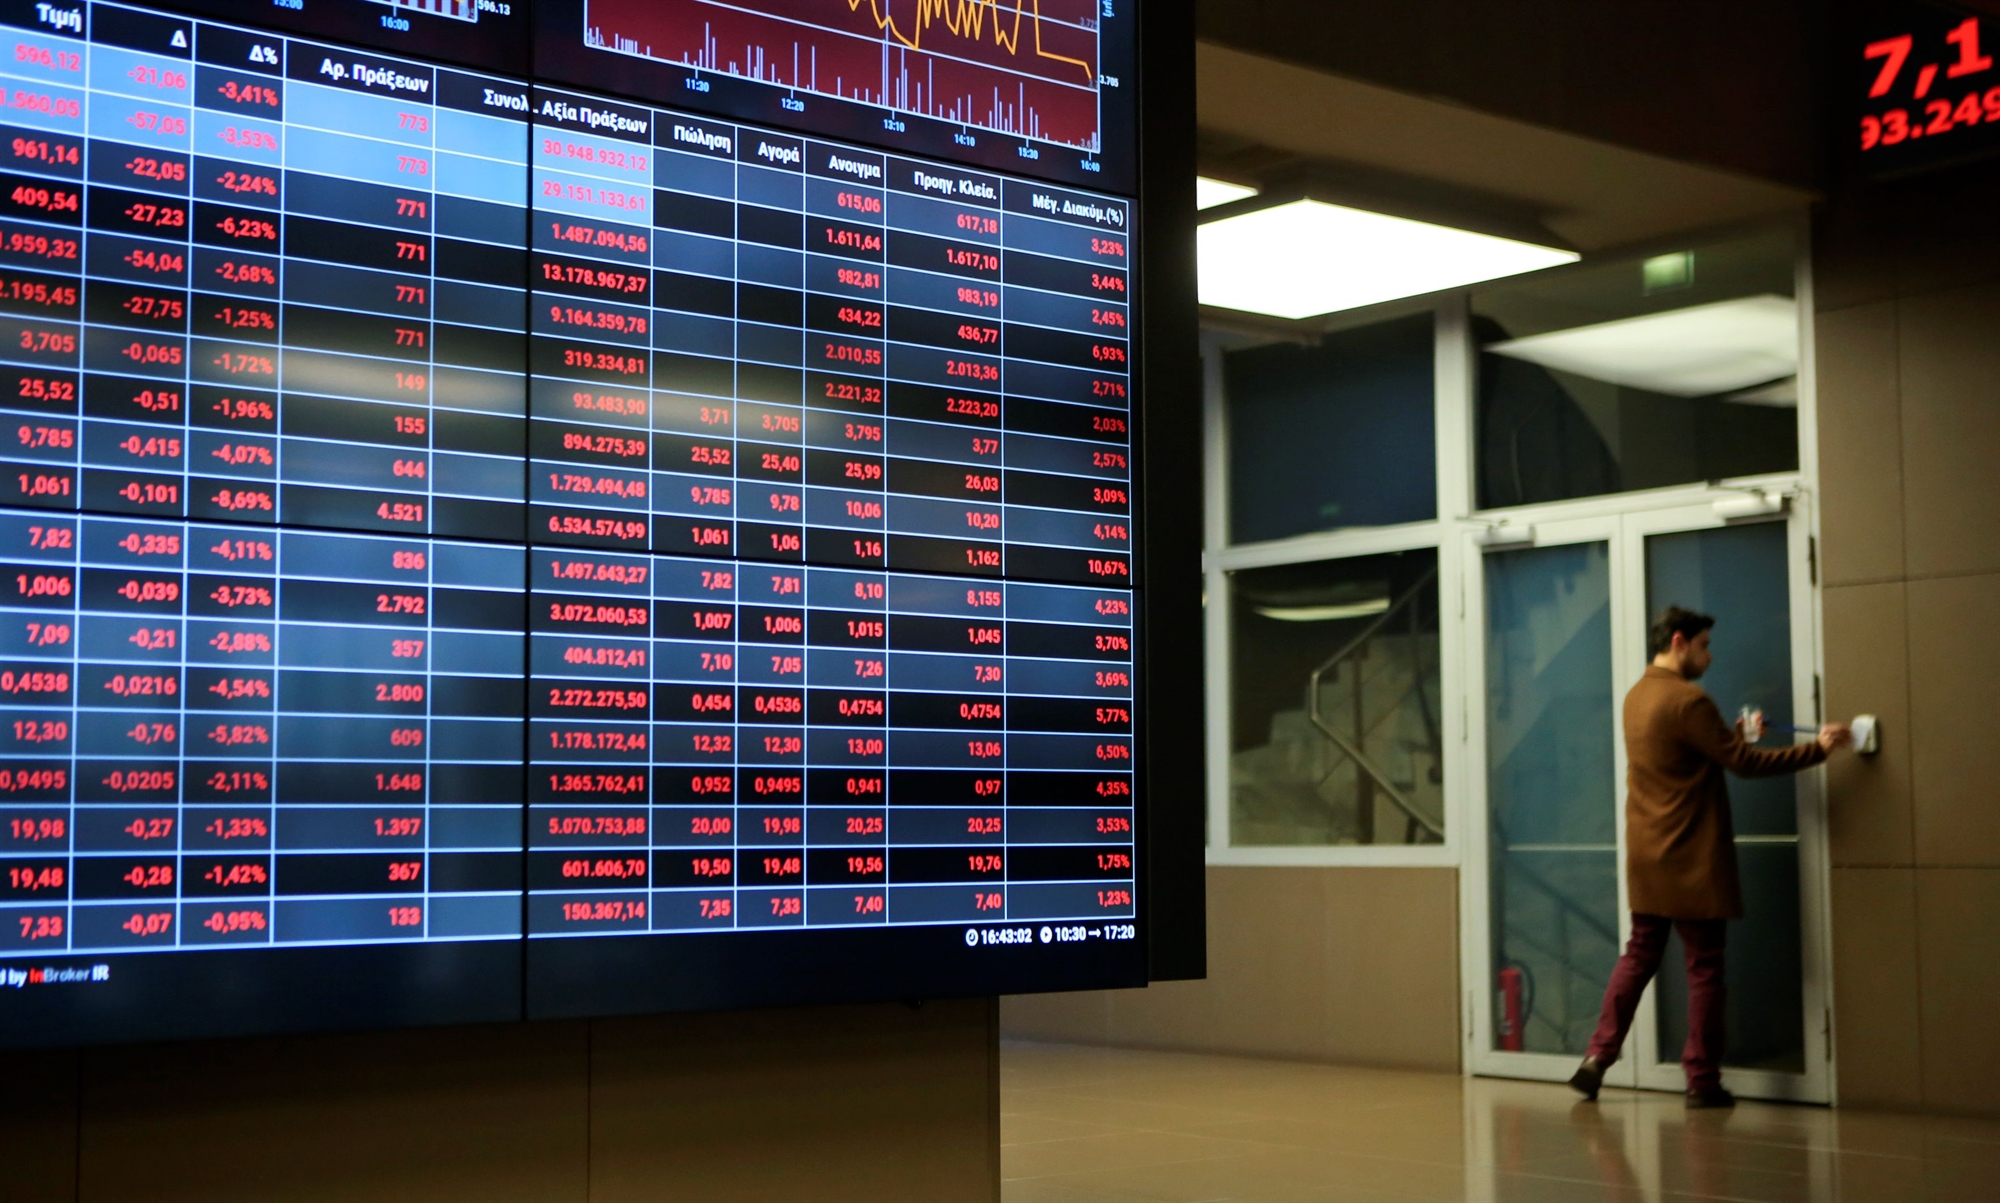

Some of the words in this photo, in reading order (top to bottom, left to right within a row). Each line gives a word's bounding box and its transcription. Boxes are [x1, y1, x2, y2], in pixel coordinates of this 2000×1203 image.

[381, 16, 410, 31] 16:00
[478, 0, 511, 16] 596.13
[1864, 16, 1993, 100] 7,1
[685, 78, 710, 93] 11:30
[781, 98, 804, 113] 12:20
[36, 3, 82, 33] Τιμή
[170, 30, 187, 48] Δ
[249, 45, 278, 65] Δ%
[320, 58, 349, 80] Αρ.
[353, 63, 429, 93] Πράξεων
[541, 100, 577, 122] Αξία
[580, 107, 648, 134] Πράξεων
[674, 125, 731, 153] Πώληση
[757, 141, 800, 164] Αγορά
[828, 155, 881, 179] Ανοιγμα
[914, 171, 957, 194] Προηγ.
[959, 180, 997, 200] Κλείσ.
[1032, 194, 1060, 215] Μέγ.
[883, 119, 906, 133] 13:10
[954, 133, 976, 147] 14:10
[1018, 146, 1039, 160] 15:30
[218, 81, 279, 107] -3,41%
[837, 191, 882, 213] 615,06
[957, 213, 999, 234] 617,18
[1091, 237, 1125, 257] 3,23%
[1080, 160, 1100, 173] 16:40
[12, 137, 80, 165] 961,14
[125, 156, 186, 182] -22,05
[216, 171, 278, 196] -2,24%
[396, 198, 427, 219] 771
[551, 223, 649, 253] 1.487.094,56
[837, 268, 881, 289] 982,81
[957, 287, 999, 307] 983,19
[1091, 309, 1125, 327] 2,45%
[11, 186, 79, 212] 409,54
[124, 203, 185, 227] -27,23
[216, 216, 277, 240] -6,23%
[395, 241, 426, 262] 771
[542, 263, 648, 293] 13.178.967,37
[837, 307, 882, 327] 434,22
[957, 324, 999, 344] 436,77
[1092, 344, 1126, 362] 6,93%
[826, 227, 882, 251] 1.611,64
[946, 248, 999, 271] 1.617,10
[1091, 273, 1125, 292] 3,44%
[123, 249, 184, 273] -54,04
[215, 261, 276, 285] -2,68%
[395, 285, 425, 305] 771
[550, 305, 648, 334] 9.164.359,78
[123, 296, 183, 319] -27,75
[214, 307, 275, 330] -1,25%
[395, 328, 424, 348] 771
[564, 349, 645, 375] 319.334,81
[946, 397, 999, 418] 2.223,20
[20, 330, 76, 354] 3,705
[122, 342, 183, 365] -0,065
[845, 423, 882, 442] 3,795
[972, 437, 999, 455] 3,77
[19, 377, 74, 402] 25,52
[132, 390, 179, 412] -0,51
[212, 398, 274, 420] -1,96%
[394, 415, 427, 435] 155
[563, 432, 647, 458] 894.275,39
[691, 445, 731, 466] 25,52
[761, 453, 801, 473] 25,40
[844, 461, 882, 481] 25,99
[965, 474, 1000, 493] 26,03
[1093, 487, 1127, 504] 3,09%
[119, 435, 181, 458] -0,415
[211, 443, 274, 465] -4,07%
[393, 459, 426, 478] 644
[549, 473, 647, 499] 1.729.494,48
[769, 493, 801, 512] 9,78
[966, 511, 1001, 530] 10,20
[18, 473, 71, 497] 1,061
[118, 481, 178, 505] -0,101
[376, 501, 424, 522] 4.521
[548, 515, 647, 541] 6.534.574,99
[691, 526, 730, 546] 1,061
[770, 533, 801, 552] 1,06
[853, 539, 883, 558] 1,16
[966, 548, 1000, 567] 1,162
[1087, 559, 1128, 577] 10,67%
[29, 526, 73, 550] 7,82
[118, 533, 181, 556] -0,335
[551, 561, 649, 585] 1.497.643,27
[701, 571, 733, 591] 7,82
[771, 575, 801, 595] 7,81
[854, 581, 885, 600] 8,10
[1095, 599, 1129, 616] 4,23%
[16, 574, 72, 598] 1,006
[376, 593, 425, 615] 2.792
[549, 603, 648, 627] 3.072.060,53
[693, 611, 733, 631] 1,007
[763, 615, 802, 635] 1,006
[847, 620, 884, 639] 1,015
[967, 627, 1002, 645] 1,045
[1095, 635, 1129, 652] 3,70%
[26, 623, 71, 646] 7,09
[129, 628, 176, 650] -0,21
[700, 652, 733, 672] 7,10
[771, 655, 803, 675] 7,05
[854, 659, 884, 678] 7,26
[974, 665, 1002, 683] 7,30
[1095, 671, 1130, 688] 3,69%
[376, 683, 424, 703] 2.800
[549, 688, 648, 710] 2.272.275,50
[691, 693, 733, 713] 0,454
[754, 695, 802, 715] 0,4536
[838, 698, 884, 717] 0,4754
[959, 702, 1002, 721] 0,4754
[1096, 707, 1130, 724] 5,77%
[128, 723, 176, 744] -0,76
[208, 724, 269, 746] -5,82%
[375, 773, 422, 791] 1.648
[691, 776, 732, 795] 0,952
[846, 777, 882, 796] 0,941
[974, 779, 1002, 796] 0,97
[1096, 781, 1130, 797] 4,35%
[10, 818, 65, 841] 19,98
[124, 818, 174, 840] -0,27
[691, 817, 732, 836] 20,00
[763, 817, 801, 836] 19,98
[846, 817, 884, 836] 20,25
[967, 817, 1002, 835] 20,25
[9, 867, 64, 891] 19,48
[123, 865, 173, 889] -0,28
[204, 864, 267, 887] -1,42%
[388, 861, 422, 881] 367
[561, 859, 646, 879] 601.606,70
[691, 858, 732, 878] 19,50
[763, 857, 801, 877] 19,48
[847, 856, 884, 875] 19,56
[968, 855, 1002, 873] 19,76
[1097, 854, 1131, 871] 1,75%
[122, 912, 173, 937] -0,07
[562, 901, 646, 922] 150.367,14
[854, 895, 884, 915] 7,40
[974, 892, 1003, 911] 7,40
[981, 928, 1032, 944] 16:43:02
[1055, 926, 1086, 941] 10:30
[1104, 925, 1135, 940] 17:20
[8, 968, 27, 987] by
[29, 967, 90, 983] InBroker
